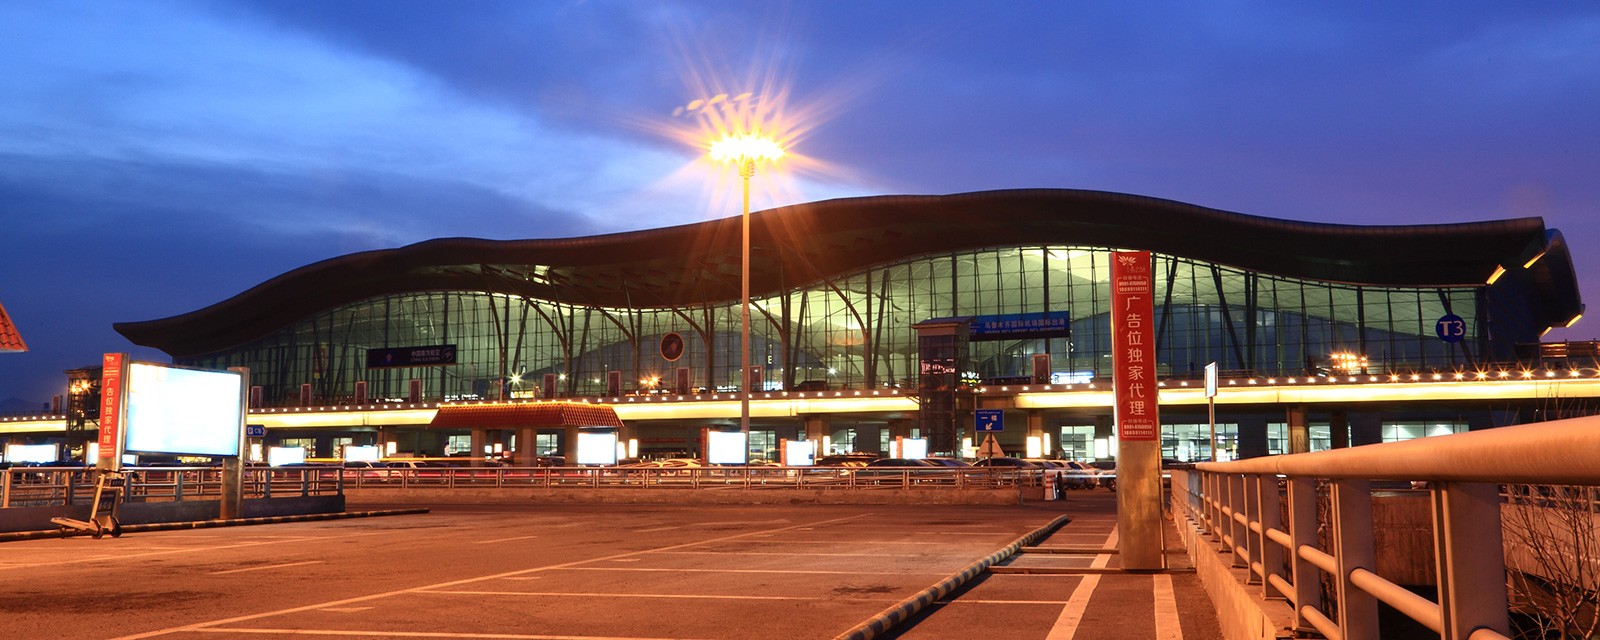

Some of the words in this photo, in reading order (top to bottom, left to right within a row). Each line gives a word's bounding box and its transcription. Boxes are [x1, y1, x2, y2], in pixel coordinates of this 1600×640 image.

[984, 319, 1064, 328] 乌鲁木齐国际机场国际出港
[1439, 320, 1464, 336] T3
[1126, 296, 1145, 415] 广告位独家代理
[103, 378, 115, 444] 广告位独家代理
